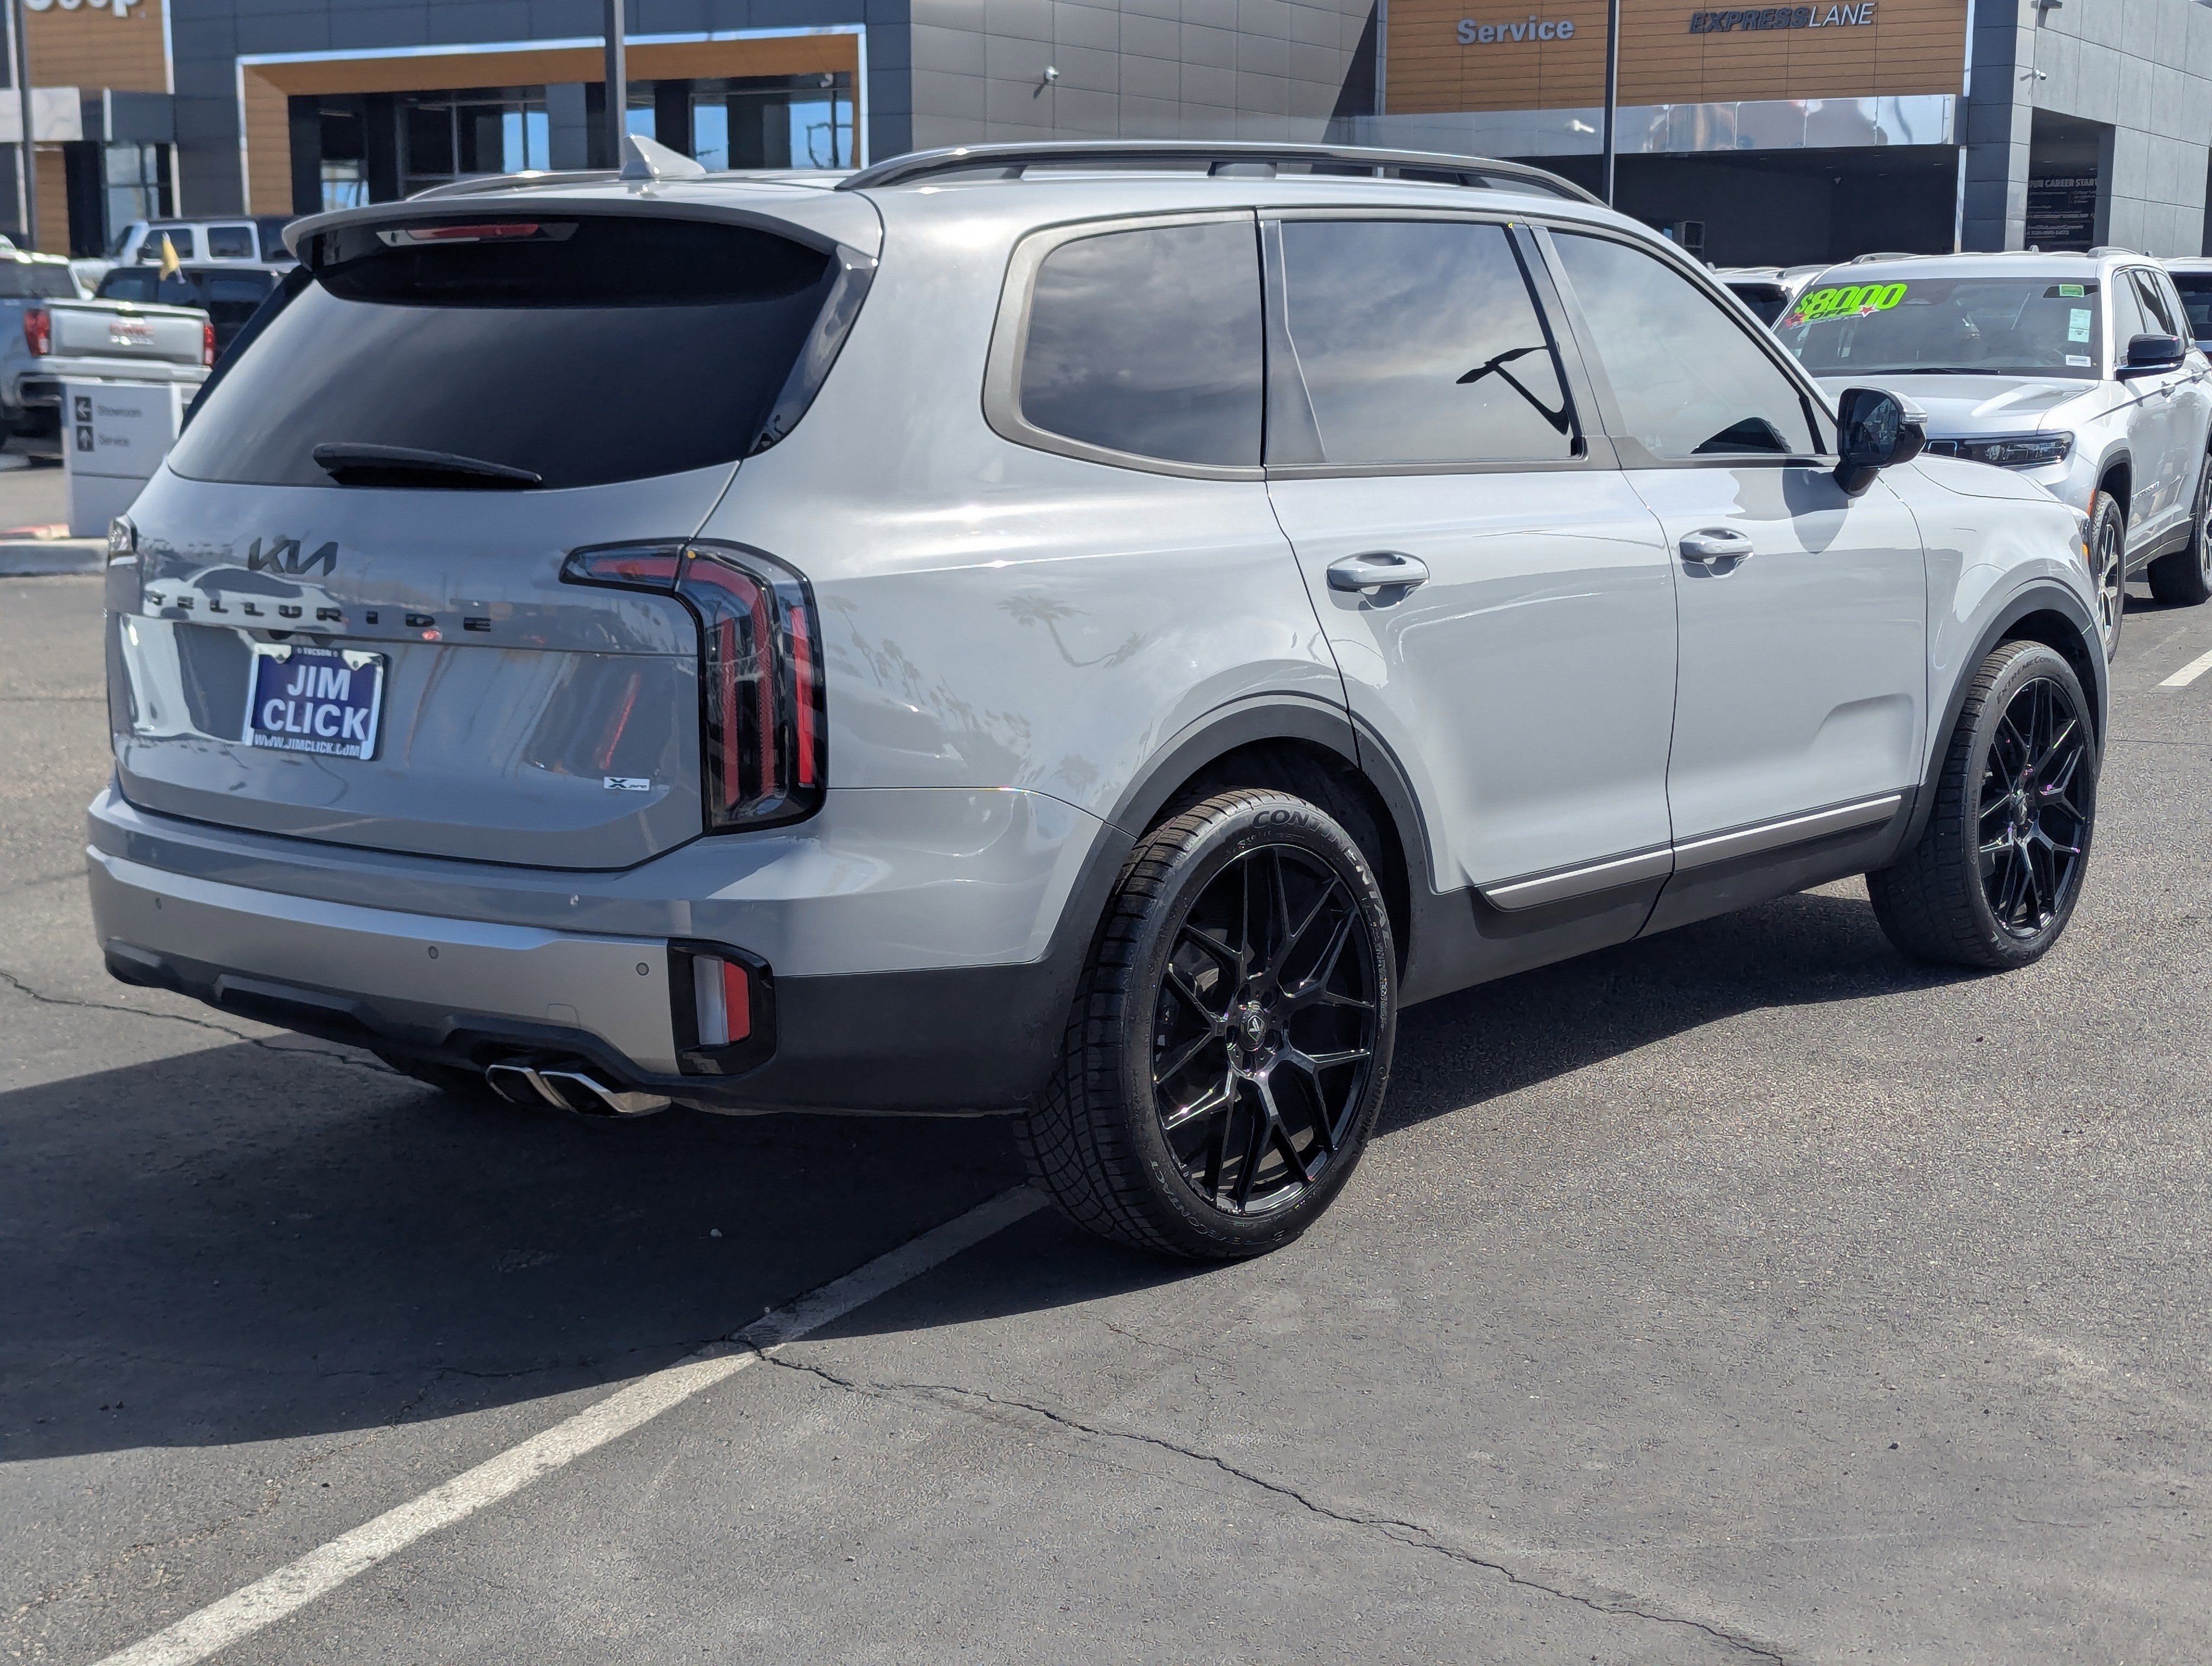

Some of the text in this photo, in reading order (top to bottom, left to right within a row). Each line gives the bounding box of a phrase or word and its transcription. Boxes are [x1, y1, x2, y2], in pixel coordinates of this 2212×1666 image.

[1457, 14, 1576, 45] Service
[1689, 2, 1875, 34] EXPRESSLANE
[1794, 283, 1908, 315] $8000
[1808, 307, 1852, 319] OFF
[248, 536, 338, 576] KIA
[144, 588, 491, 632] TELLURIDE
[303, 647, 332, 657] TUCSON
[287, 664, 351, 701] JIM
[263, 699, 370, 741] CLICK
[254, 734, 361, 757] WWW.JIMCLICK.COM
